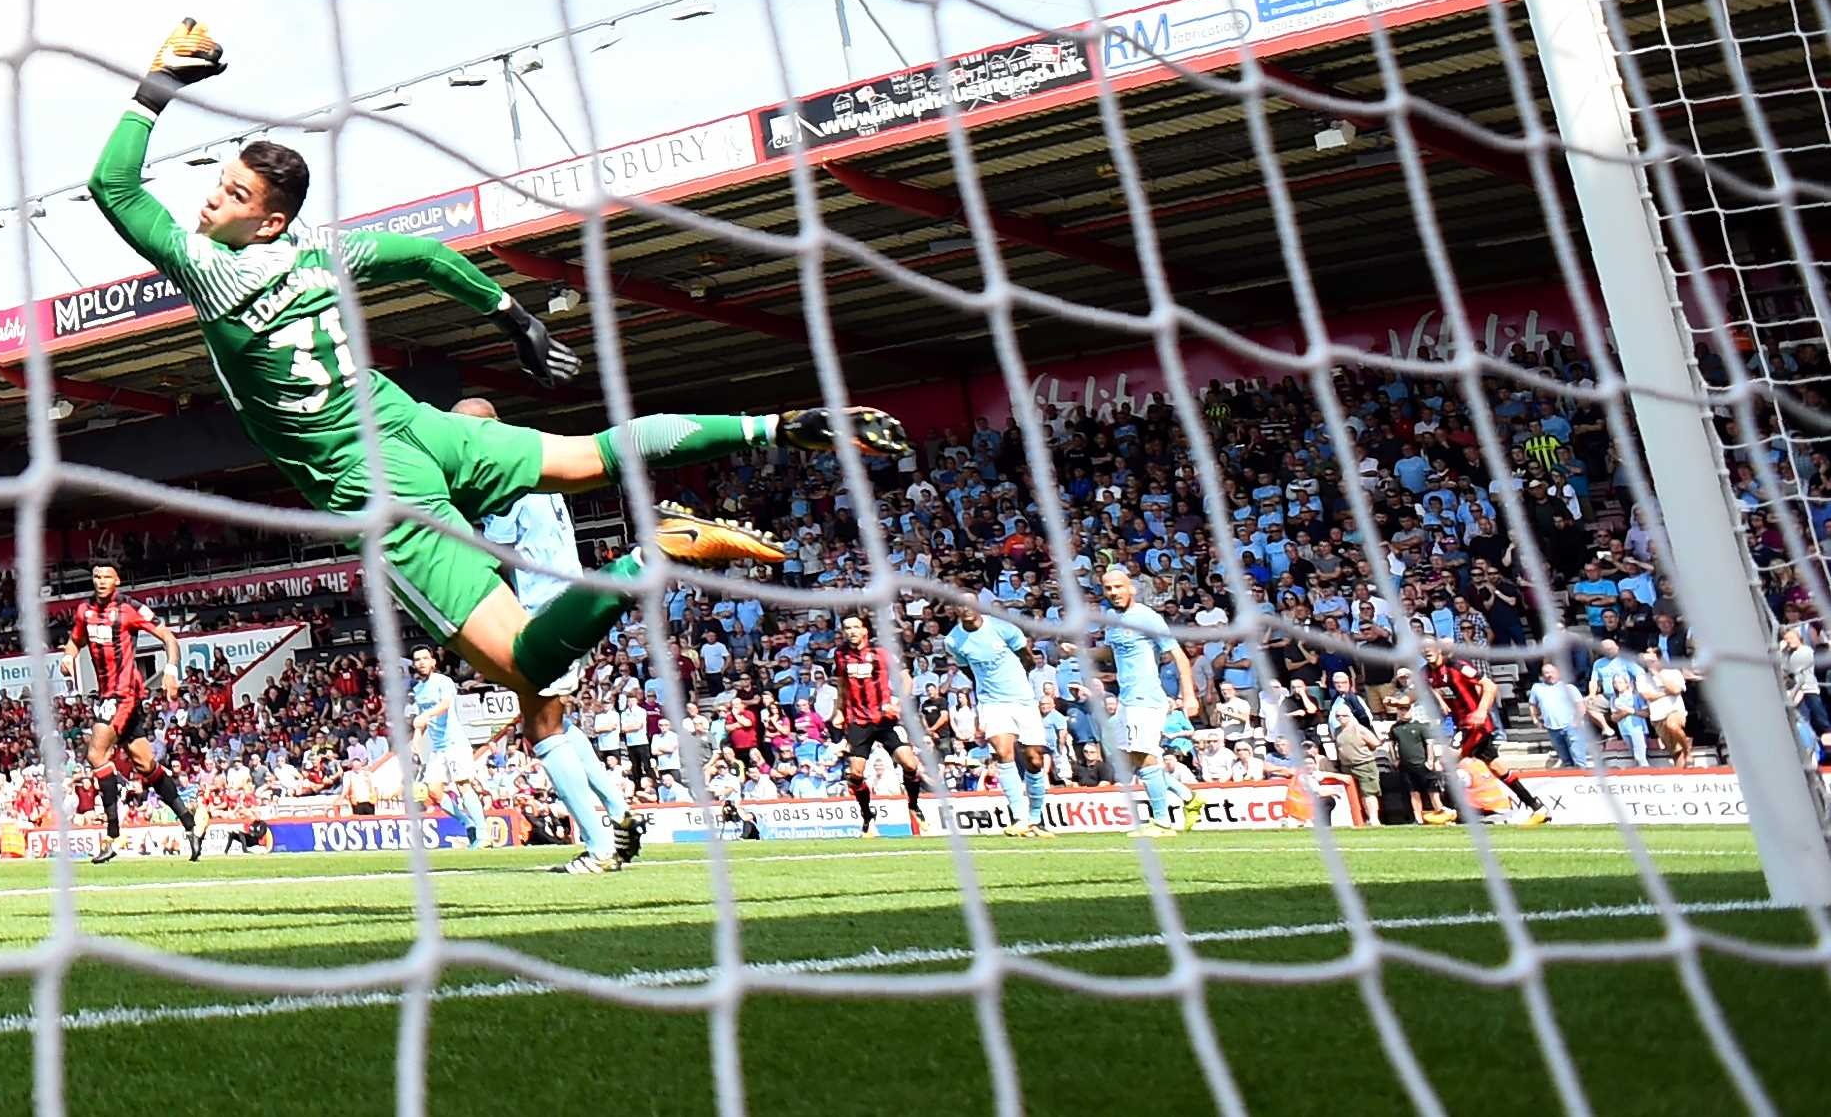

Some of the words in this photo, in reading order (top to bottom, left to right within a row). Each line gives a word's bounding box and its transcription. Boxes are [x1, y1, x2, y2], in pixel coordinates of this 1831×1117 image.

[1104, 12, 1170, 67] RM
[515, 130, 709, 208] SPETSBURY
[388, 207, 443, 234] GROUP
[54, 279, 140, 336] MPLOY
[142, 279, 182, 303] STA
[318, 570, 349, 594] THE
[485, 694, 515, 715] EV3
[31, 836, 94, 859] EXPESS
